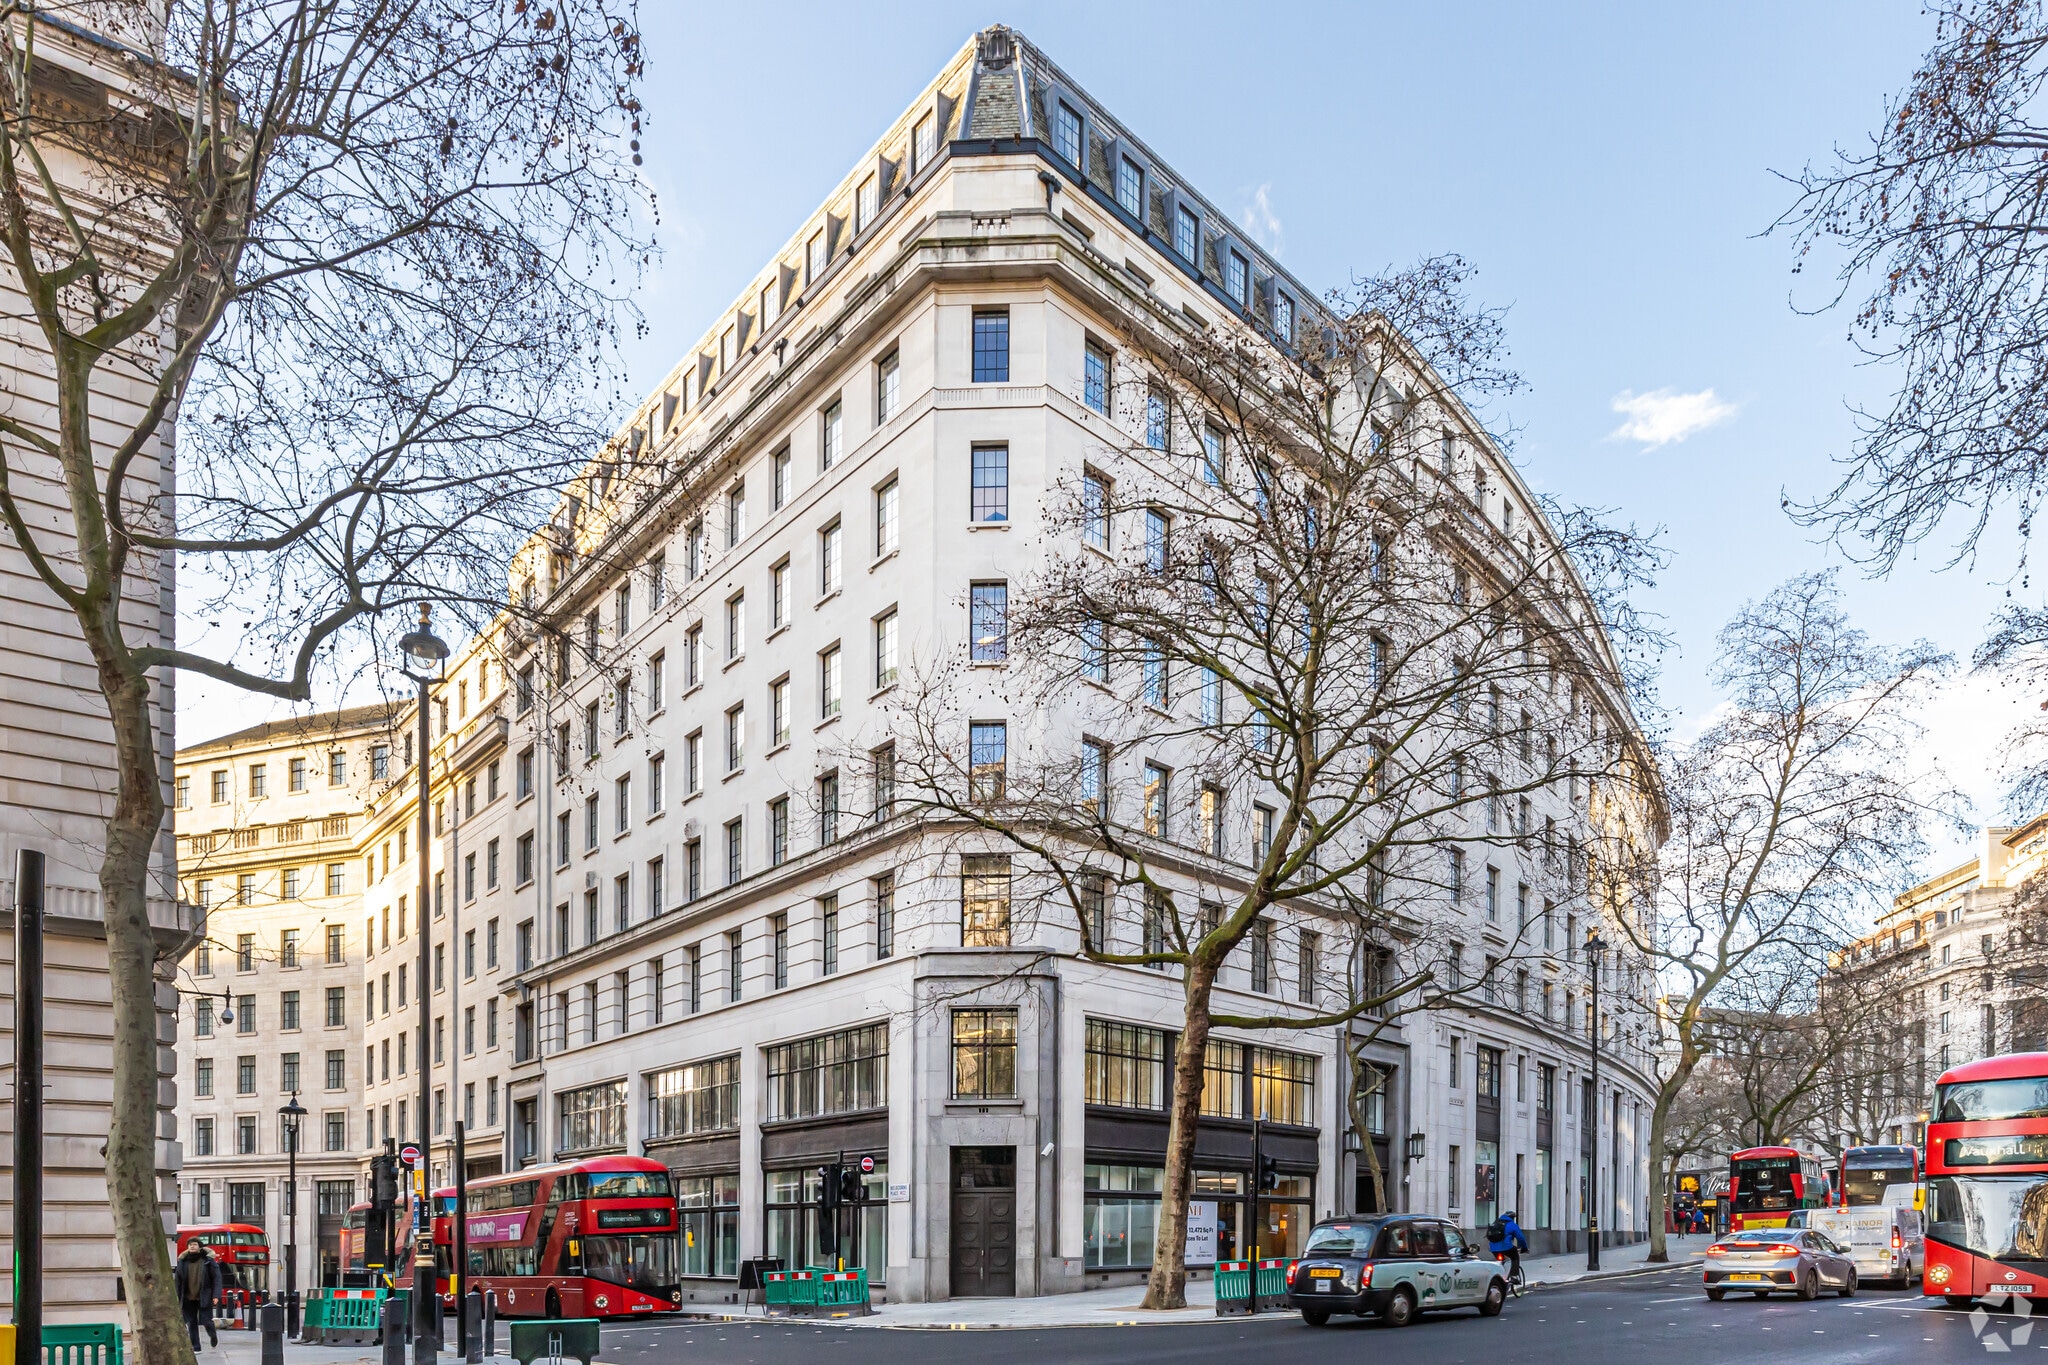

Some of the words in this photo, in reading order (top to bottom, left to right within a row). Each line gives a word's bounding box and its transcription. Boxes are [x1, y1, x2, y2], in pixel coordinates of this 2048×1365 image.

[1761, 1171, 1768, 1179] 6
[1873, 1171, 1885, 1180] 26
[653, 1212, 661, 1223] 9
[1454, 1278, 1480, 1290] Mindler
